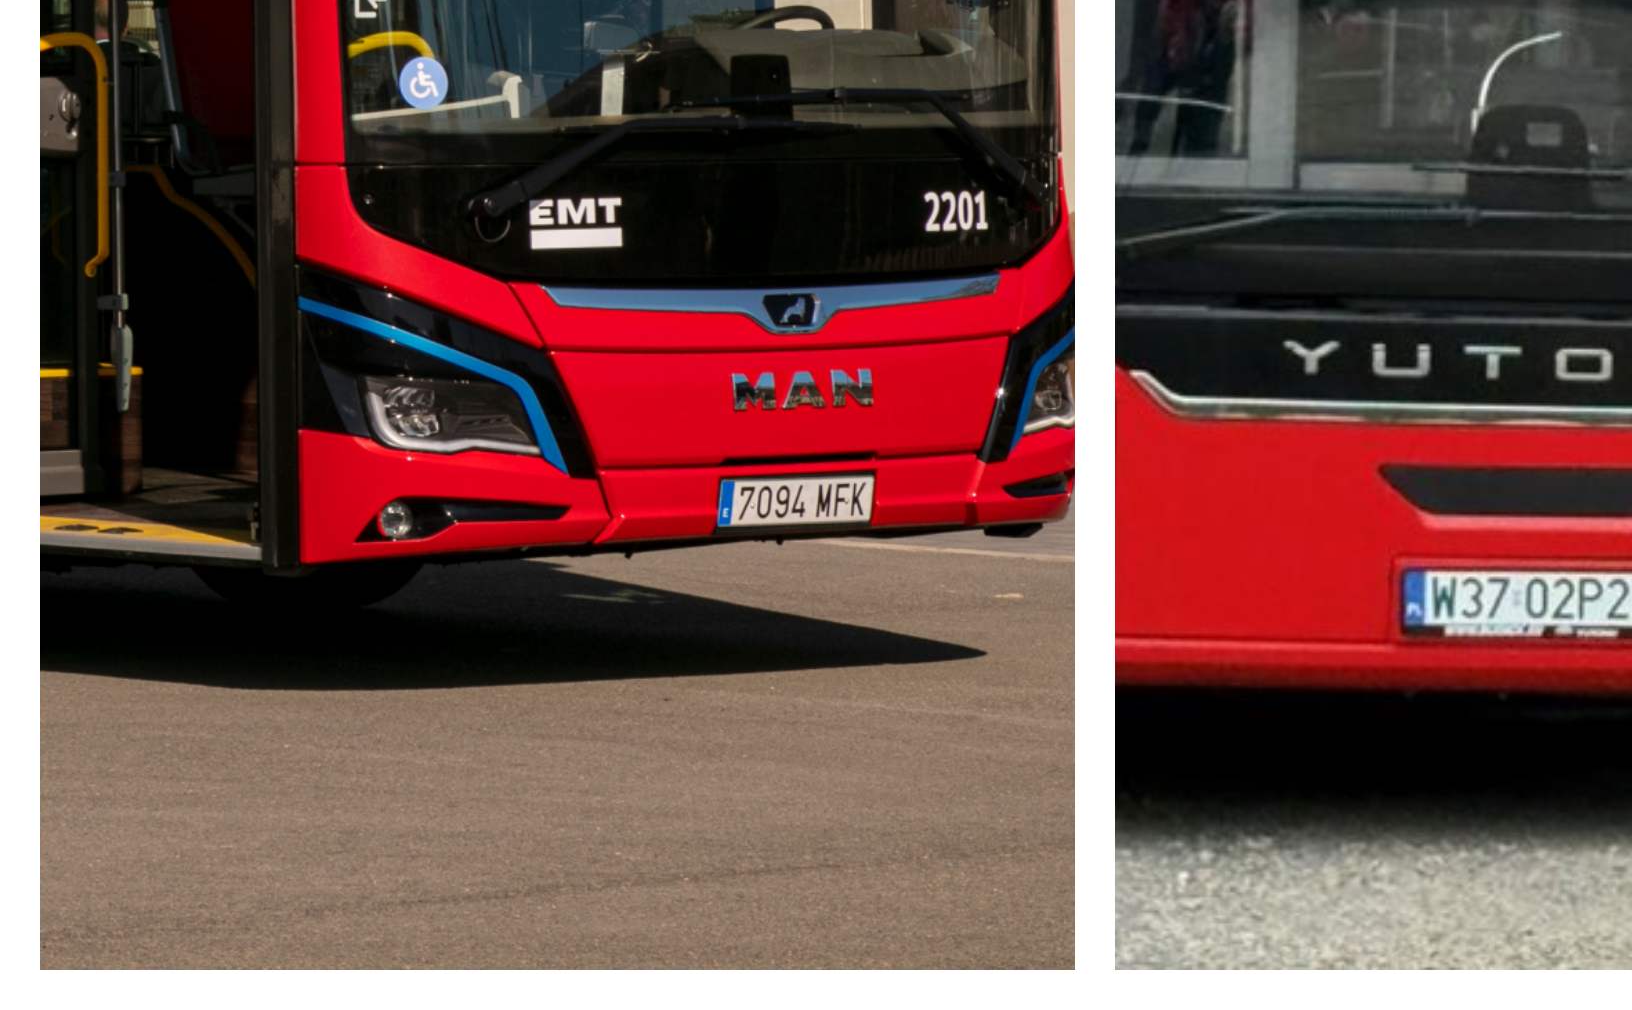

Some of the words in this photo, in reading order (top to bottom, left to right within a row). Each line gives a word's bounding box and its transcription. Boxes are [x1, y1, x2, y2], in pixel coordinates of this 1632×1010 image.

[529, 196, 622, 227] EMT
[924, 190, 989, 233] 2201
[731, 368, 875, 411] MAN
[738, 484, 805, 521] 7094
[815, 481, 867, 518] MFK
[1431, 575, 1510, 619] W37
